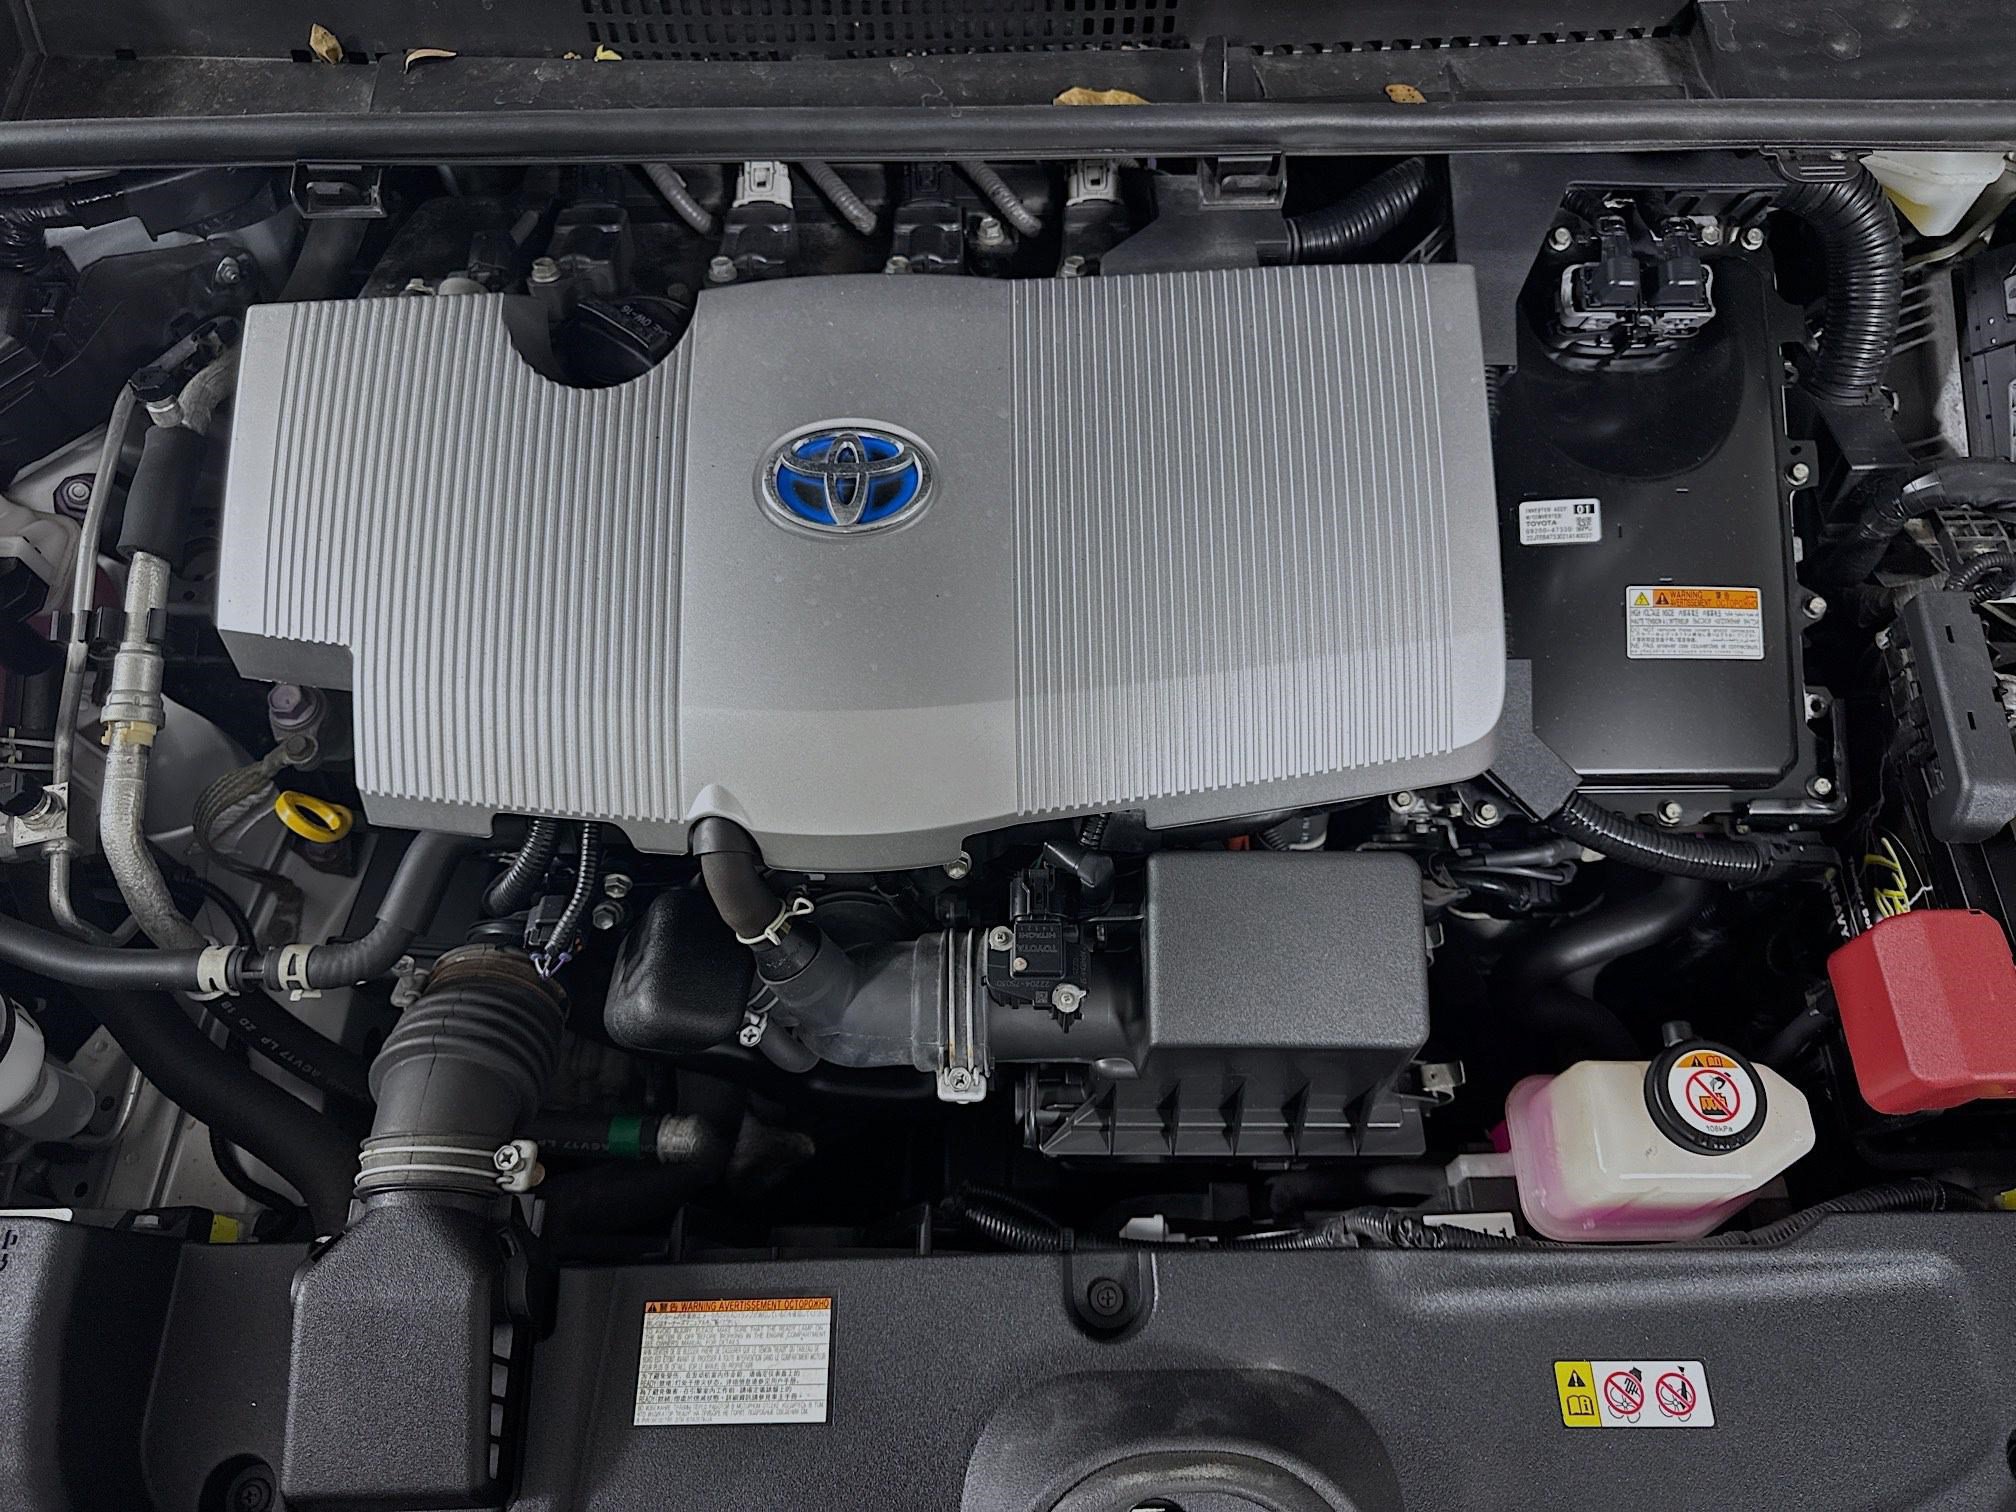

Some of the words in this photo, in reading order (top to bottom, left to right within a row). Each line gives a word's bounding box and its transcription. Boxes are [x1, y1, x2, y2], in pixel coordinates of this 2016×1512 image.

[1576, 505, 1591, 513] 01
[1670, 590, 1703, 599] WARNING
[1862, 908, 1873, 930] Bol
[1018, 931, 1057, 939] HITACHI
[1016, 943, 1058, 953] TOYOTA
[681, 1301, 717, 1312] WARNING
[718, 1300, 782, 1311] AVERTISSEMENT
